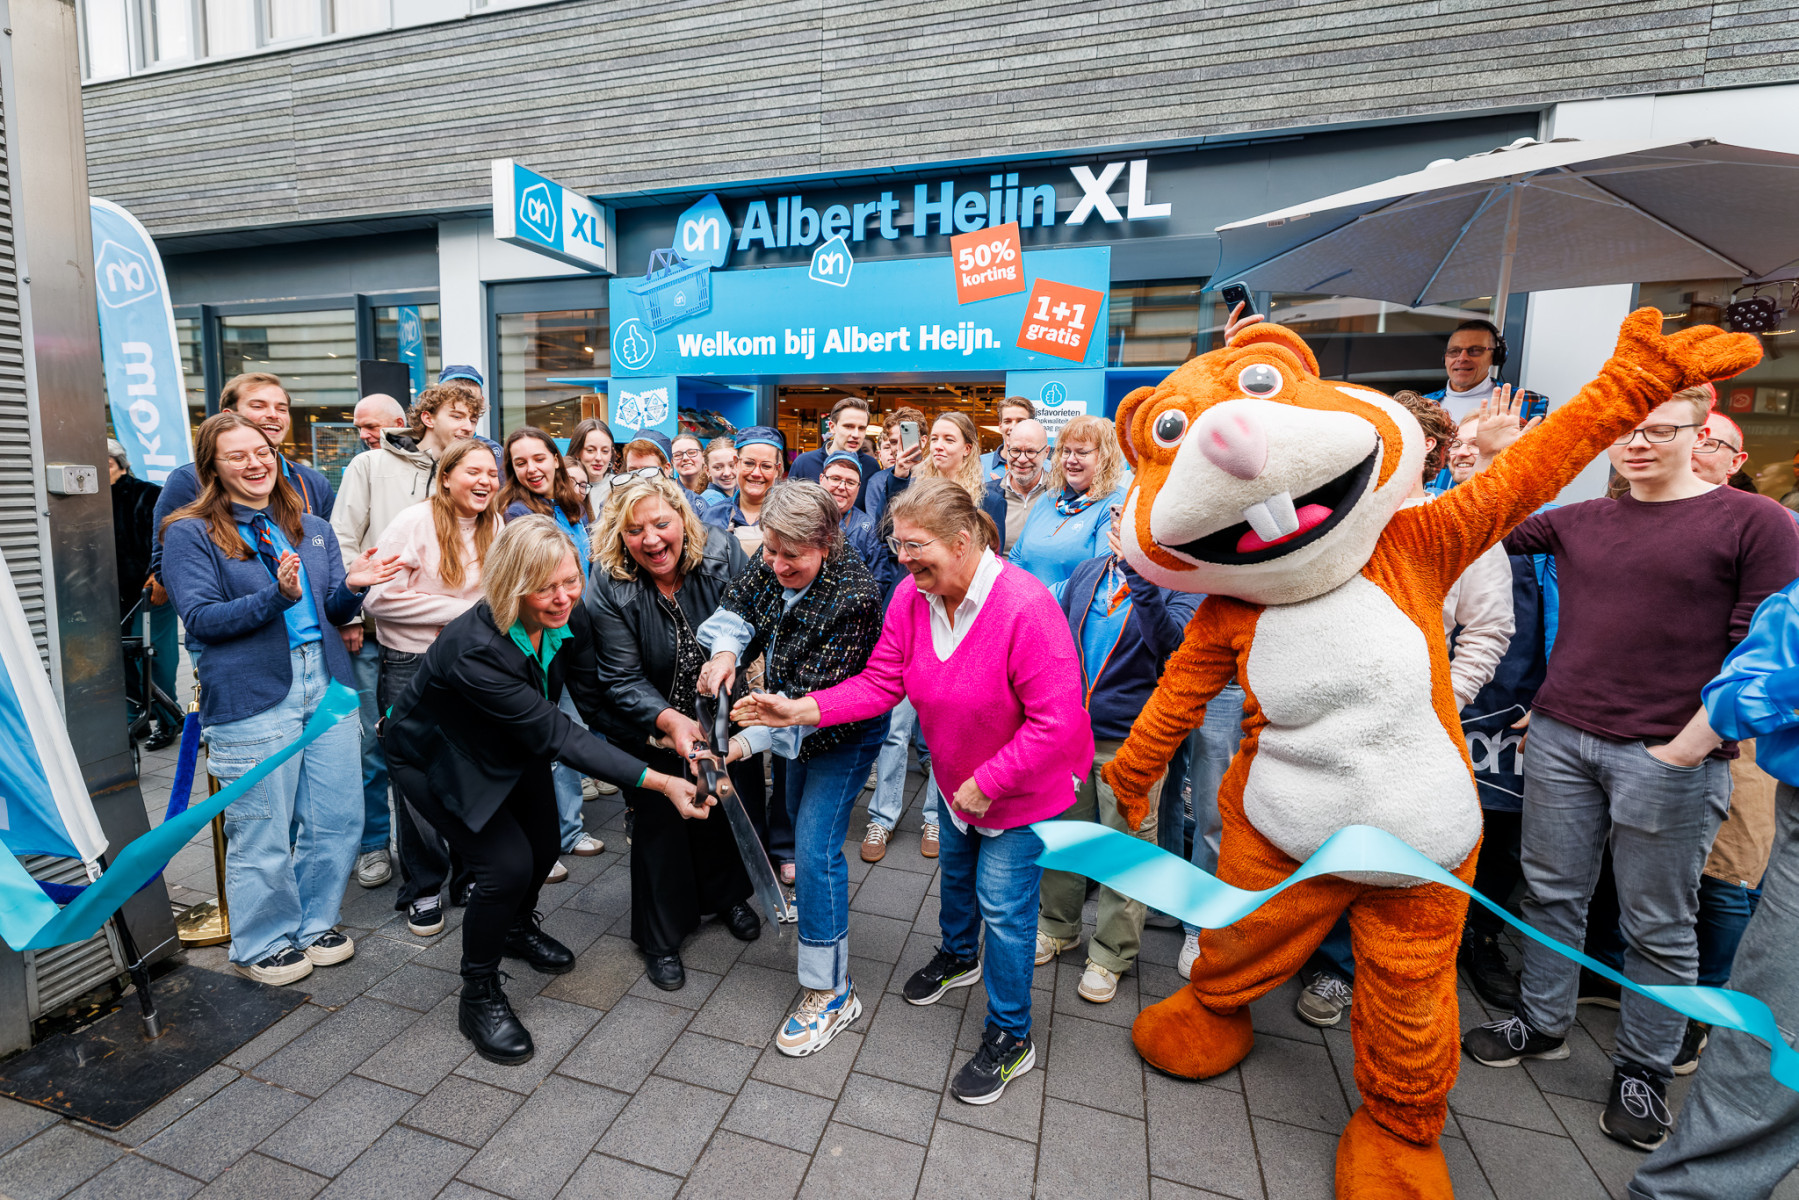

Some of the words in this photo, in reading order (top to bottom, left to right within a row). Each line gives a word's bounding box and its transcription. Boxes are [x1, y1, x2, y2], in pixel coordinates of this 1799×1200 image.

[737, 191, 900, 251] Albert
[913, 172, 1057, 237] Heijn
[1064, 158, 1172, 226] XL
[571, 207, 605, 250] XL
[959, 238, 1016, 271] 50%
[962, 265, 1017, 287] korting
[1033, 295, 1087, 330] 1+1
[677, 331, 776, 357] Welkom
[784, 328, 815, 360] bij
[823, 326, 911, 354] Albert
[919, 321, 1001, 356] Heijn.
[1025, 322, 1081, 348] gratis
[1035, 408, 1081, 417] jsfavorieten
